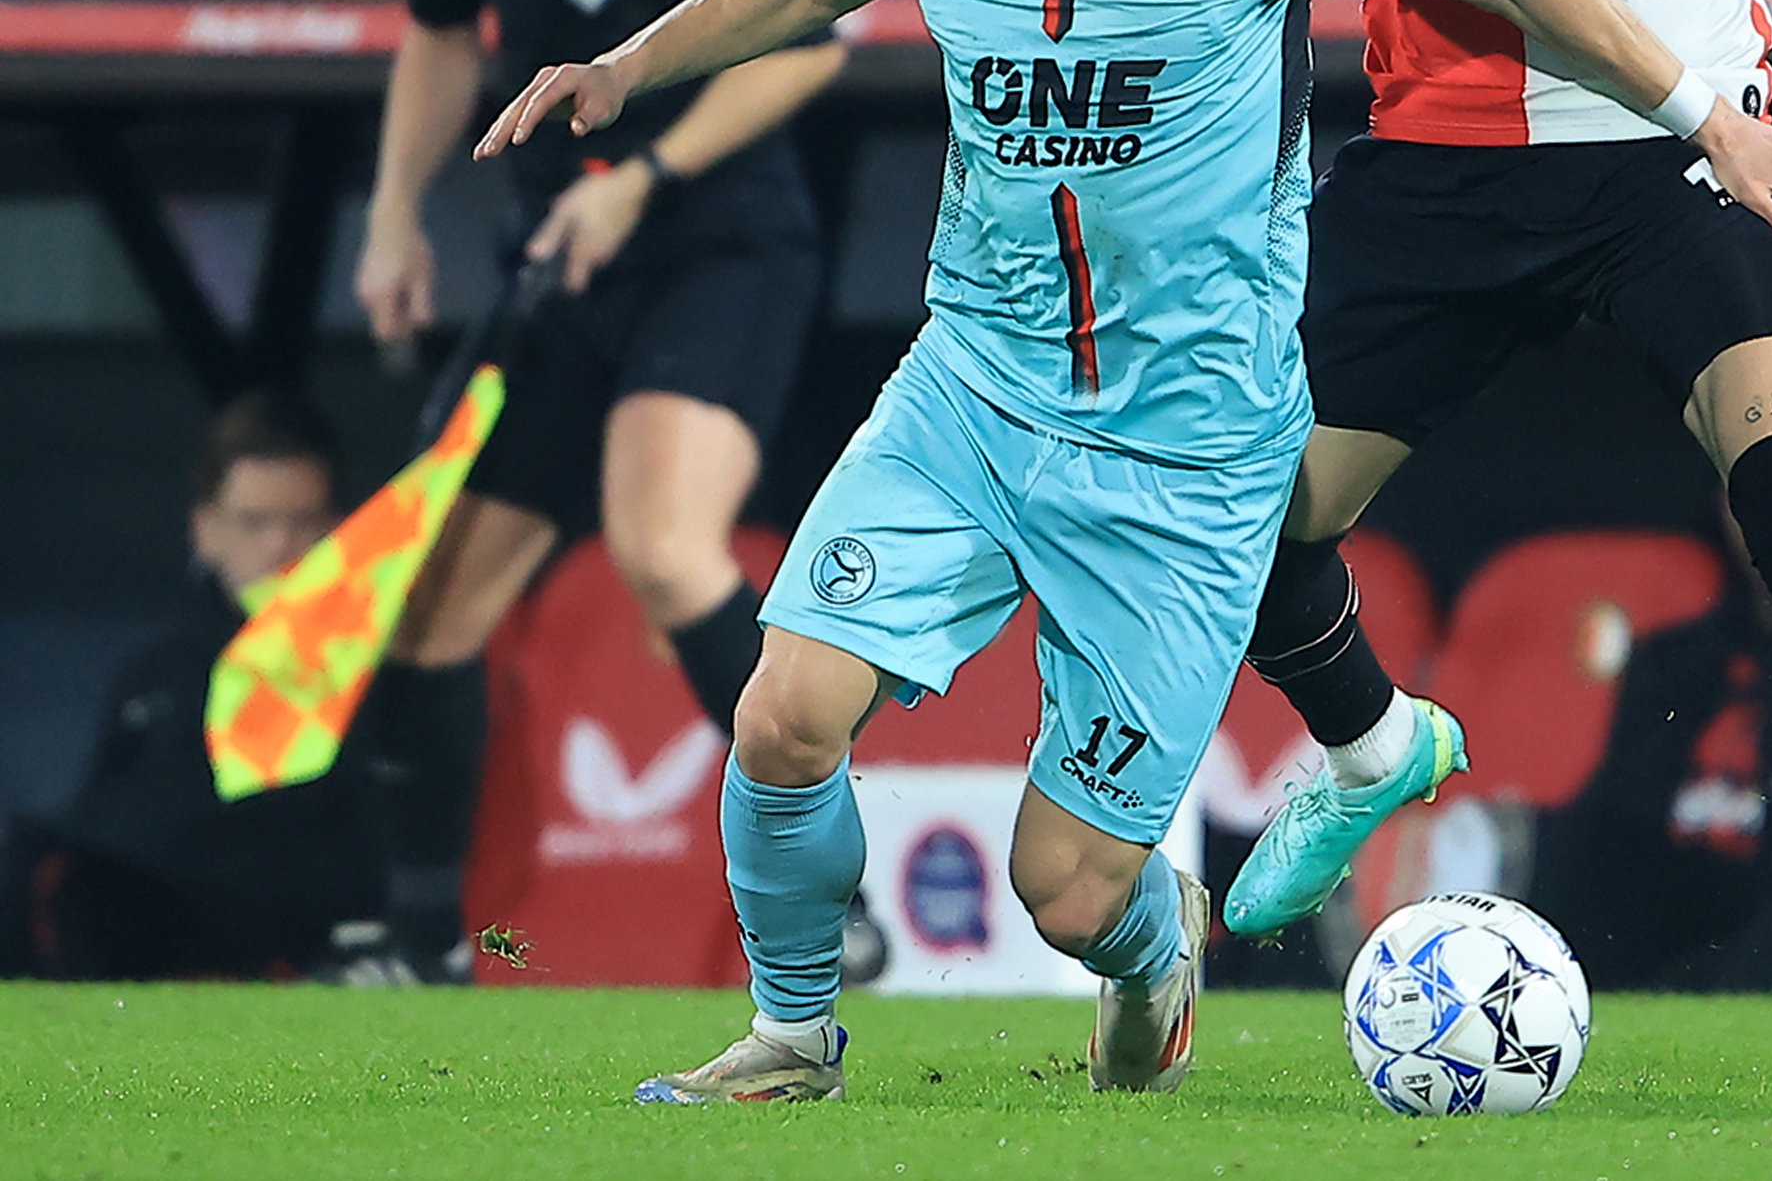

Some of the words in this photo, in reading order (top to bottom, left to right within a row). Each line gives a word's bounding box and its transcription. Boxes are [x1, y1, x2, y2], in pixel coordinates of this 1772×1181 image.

[970, 56, 1168, 129] ONE
[995, 133, 1142, 167] CASINO
[1074, 715, 1148, 777] 17
[1060, 756, 1127, 800] CRAFT
